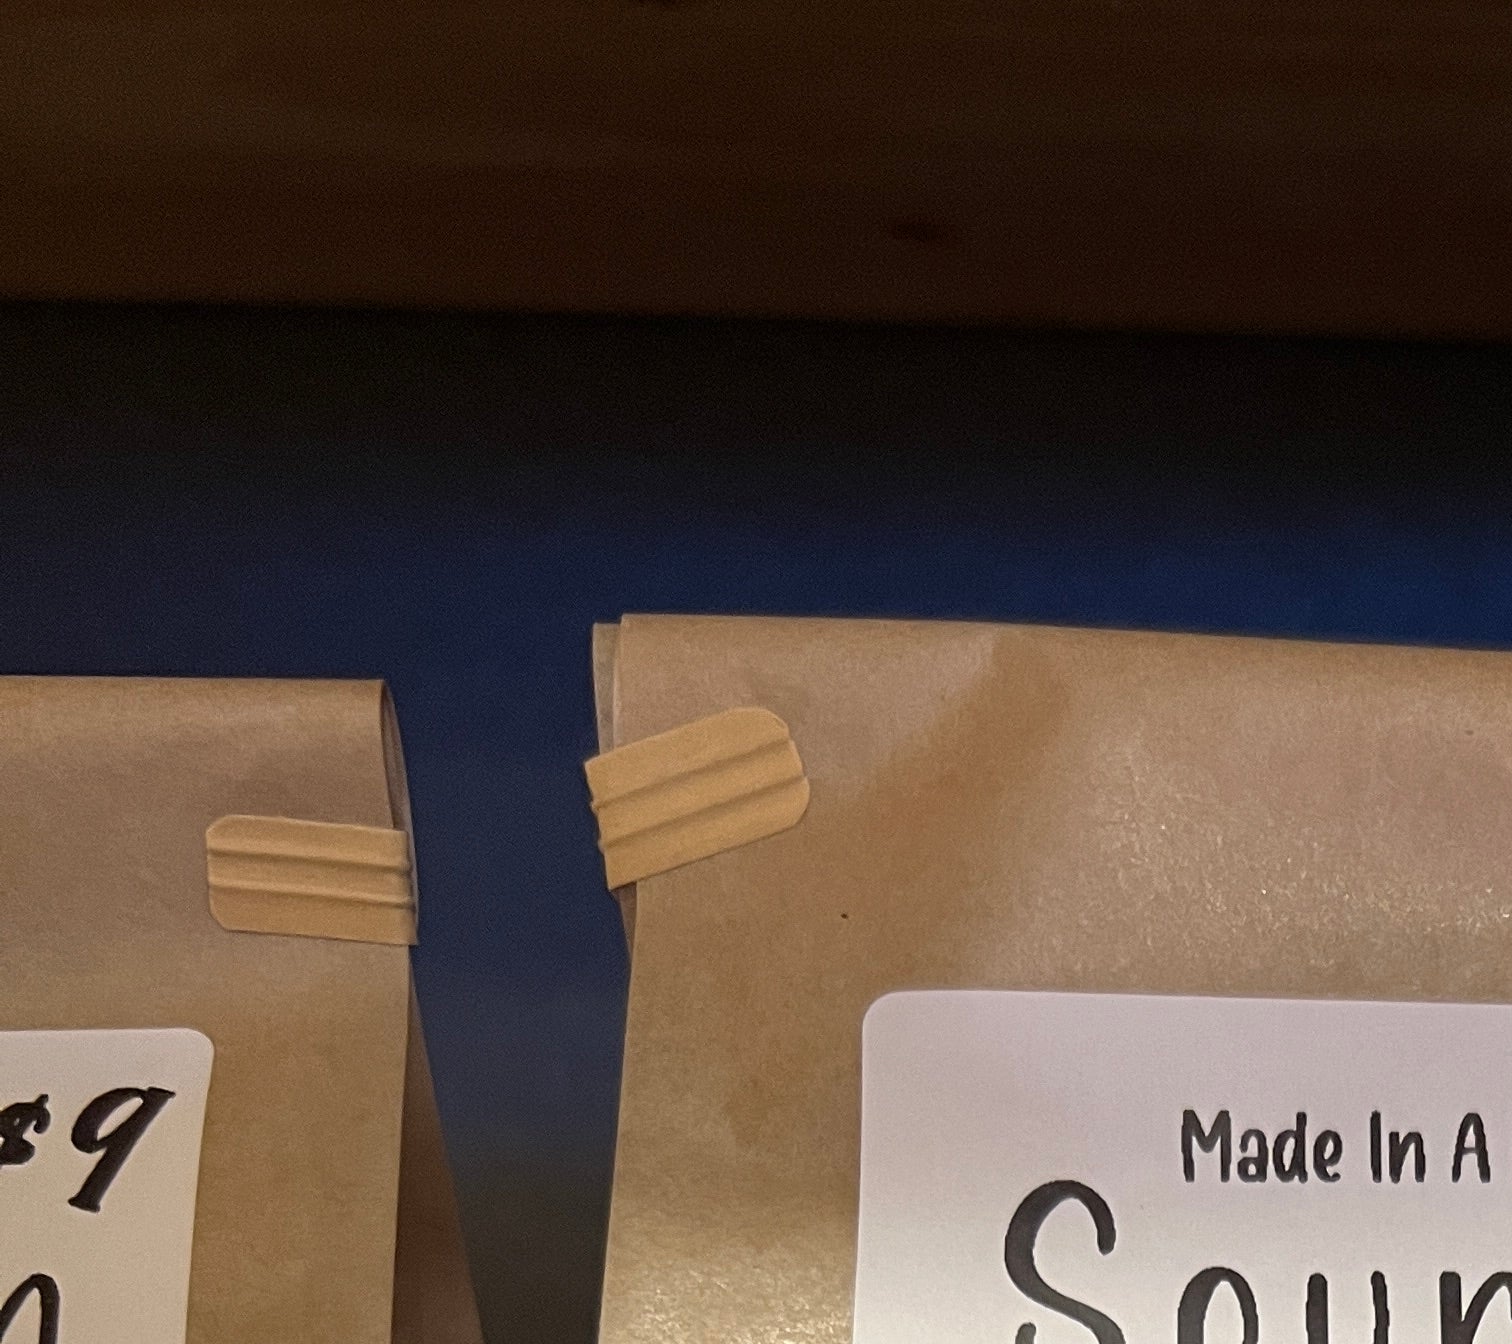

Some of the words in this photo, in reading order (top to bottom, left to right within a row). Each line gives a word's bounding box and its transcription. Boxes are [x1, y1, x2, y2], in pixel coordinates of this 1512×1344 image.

[1180, 1108, 1344, 1185] Made
[1369, 1109, 1427, 1185] In
[1451, 1111, 1492, 1184] A
